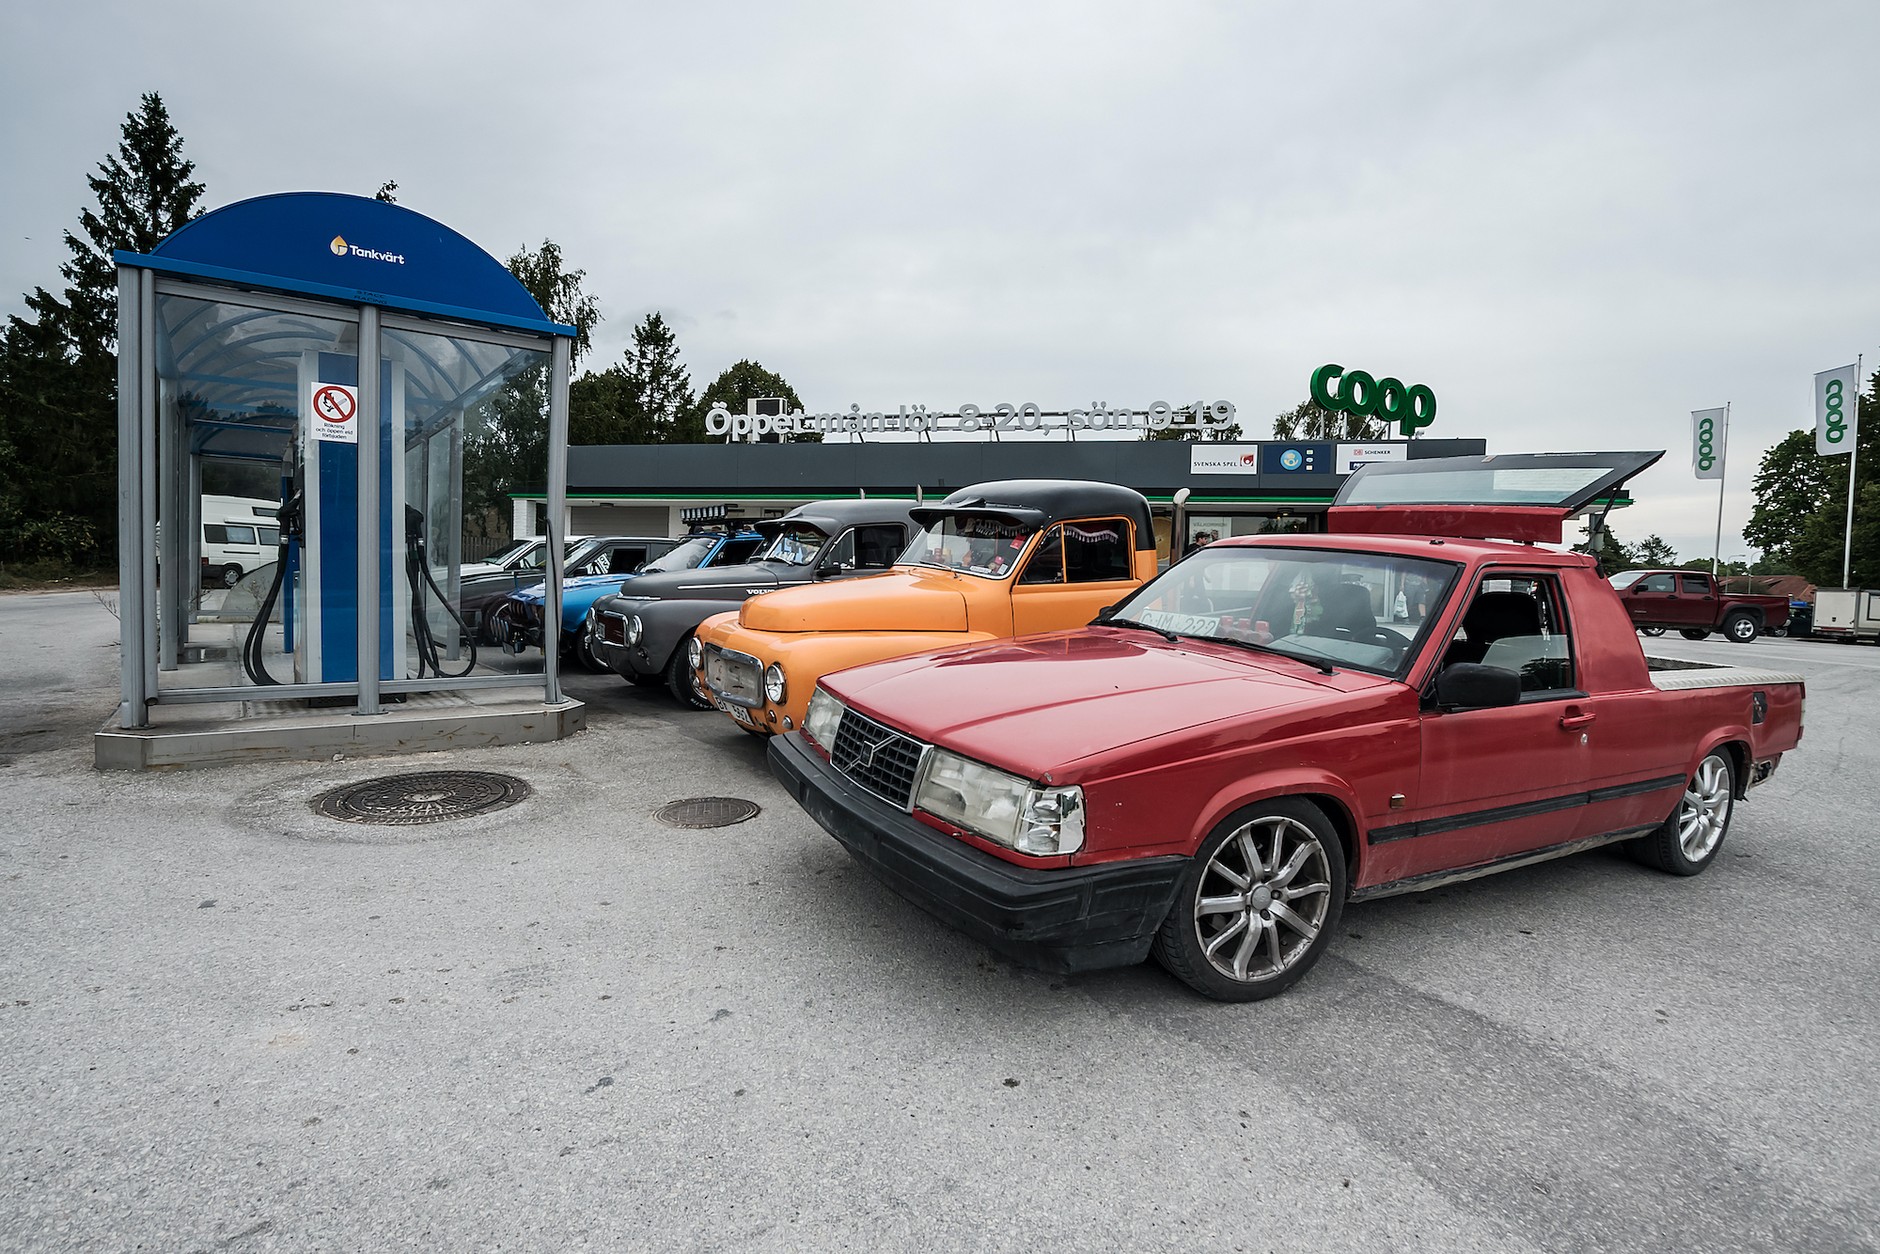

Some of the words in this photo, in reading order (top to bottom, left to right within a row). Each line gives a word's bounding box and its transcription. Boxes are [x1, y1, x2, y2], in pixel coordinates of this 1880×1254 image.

[350, 244, 405, 265] Tankvärt
[705, 401, 806, 442] Öppet
[814, 402, 943, 433] mån-lör
[958, 402, 1051, 436] 8-20,
[1068, 401, 1133, 431] sön
[1148, 400, 1235, 431] 9-19
[1310, 363, 1437, 437] coop
[1825, 379, 1848, 444] coop
[1698, 418, 1717, 472] coop
